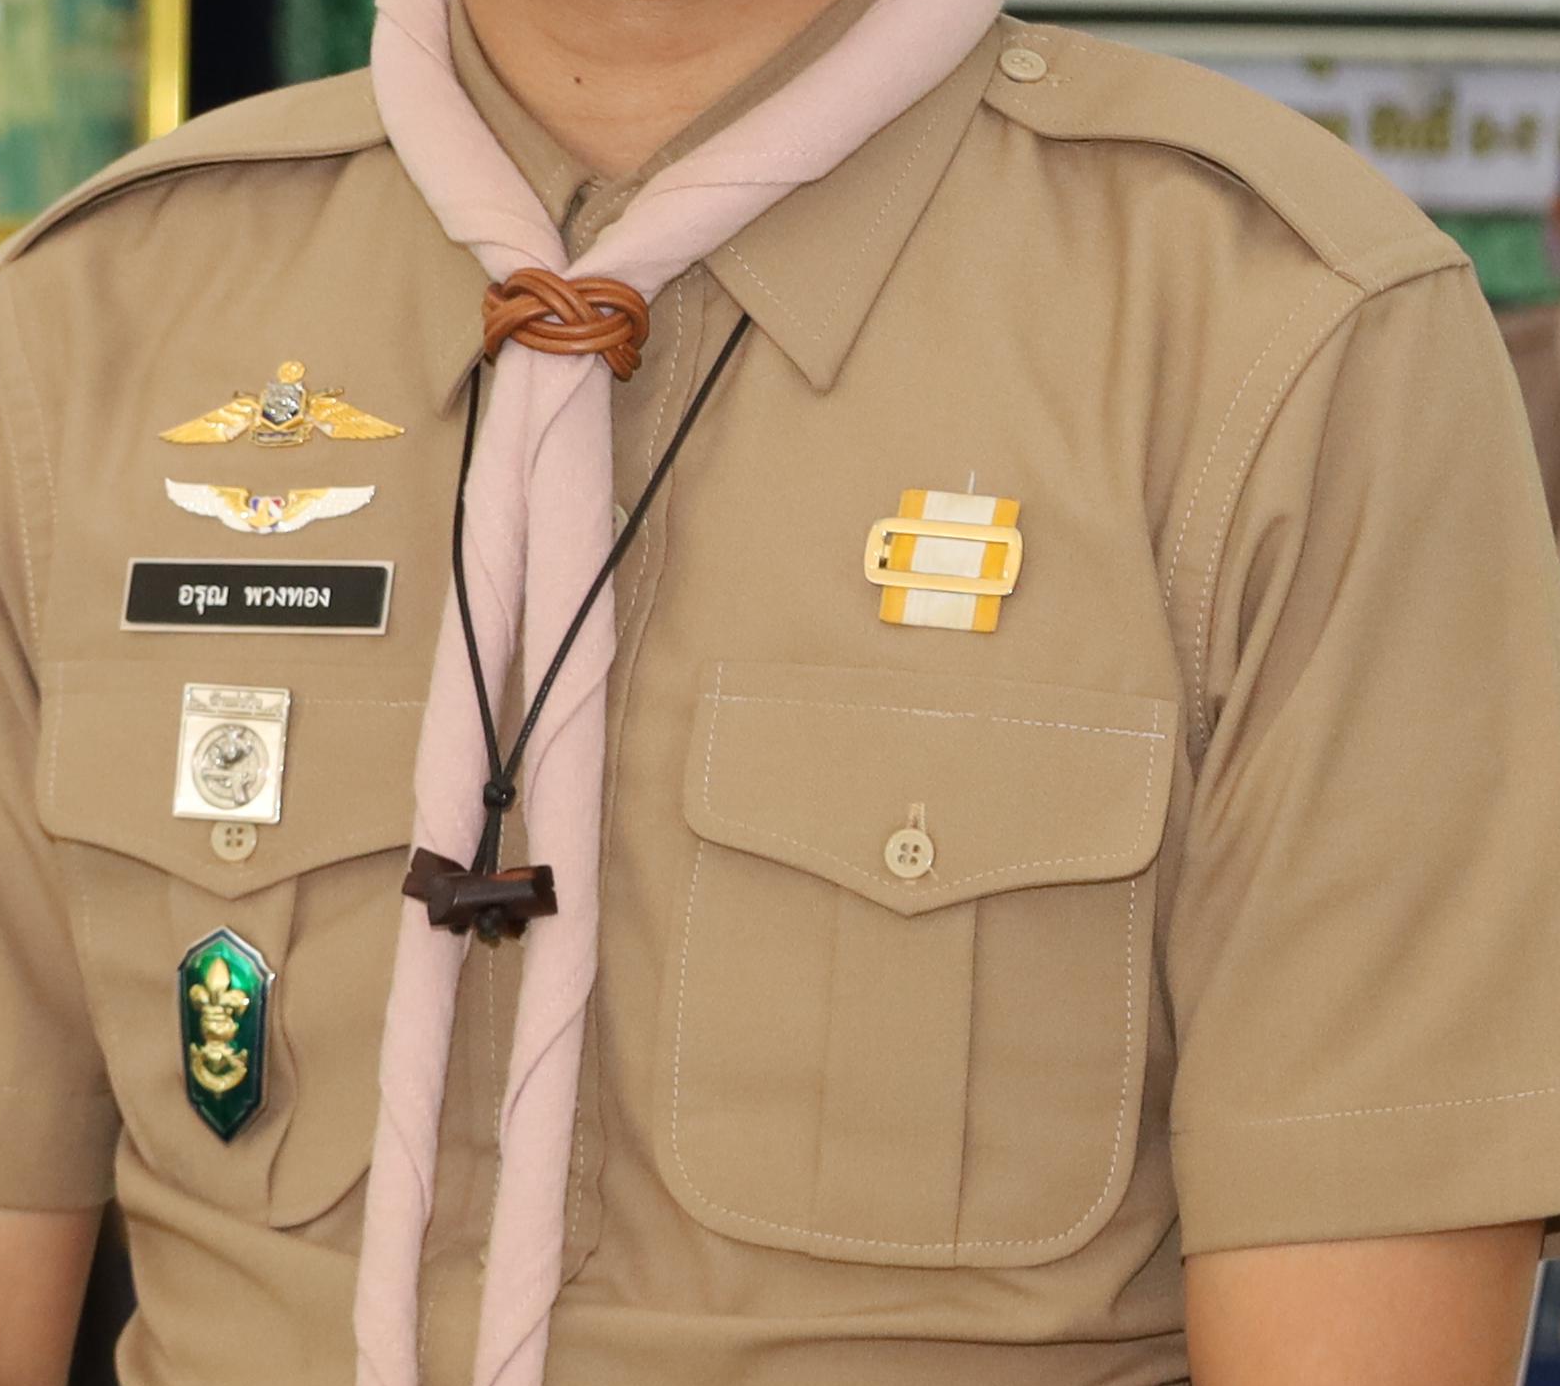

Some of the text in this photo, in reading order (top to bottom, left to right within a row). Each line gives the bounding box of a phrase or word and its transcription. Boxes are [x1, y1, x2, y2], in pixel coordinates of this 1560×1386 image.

[178, 584, 331, 615] อรุณ พวงทอง
